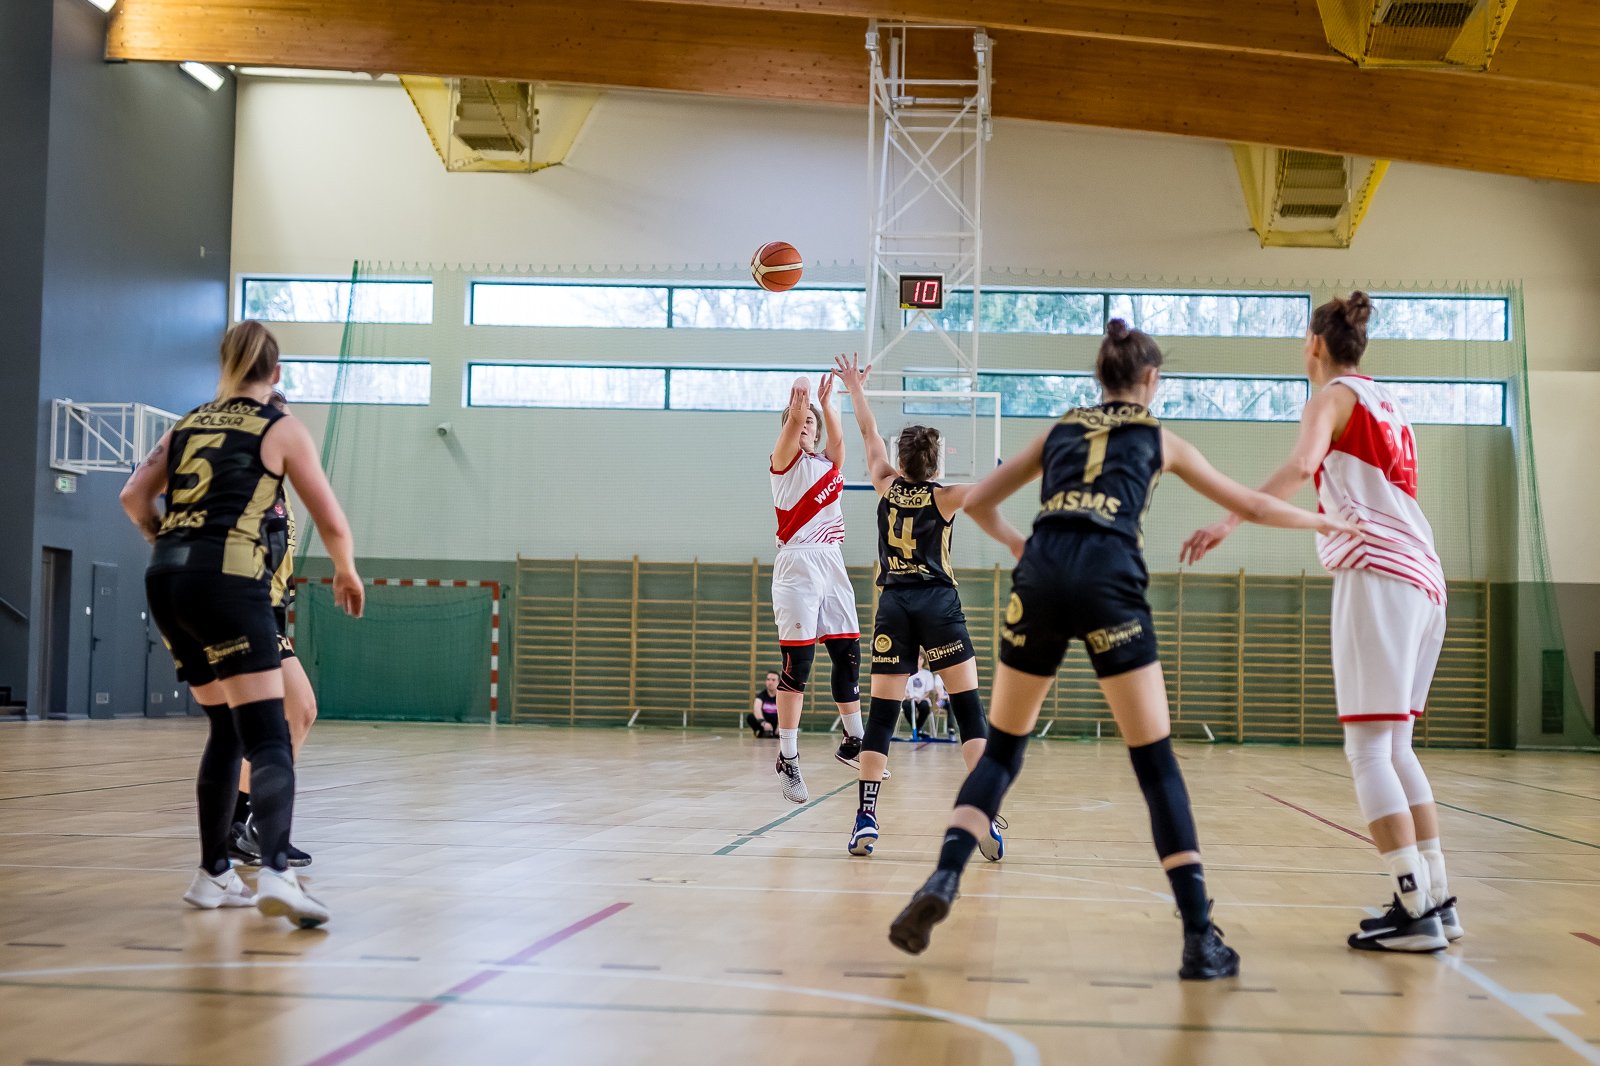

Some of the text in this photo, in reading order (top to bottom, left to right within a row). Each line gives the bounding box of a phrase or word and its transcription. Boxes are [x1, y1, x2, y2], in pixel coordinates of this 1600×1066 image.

[914, 281, 939, 303] 10
[192, 415, 244, 426] POLSKA
[172, 433, 227, 505] 5
[888, 507, 917, 559] 4
